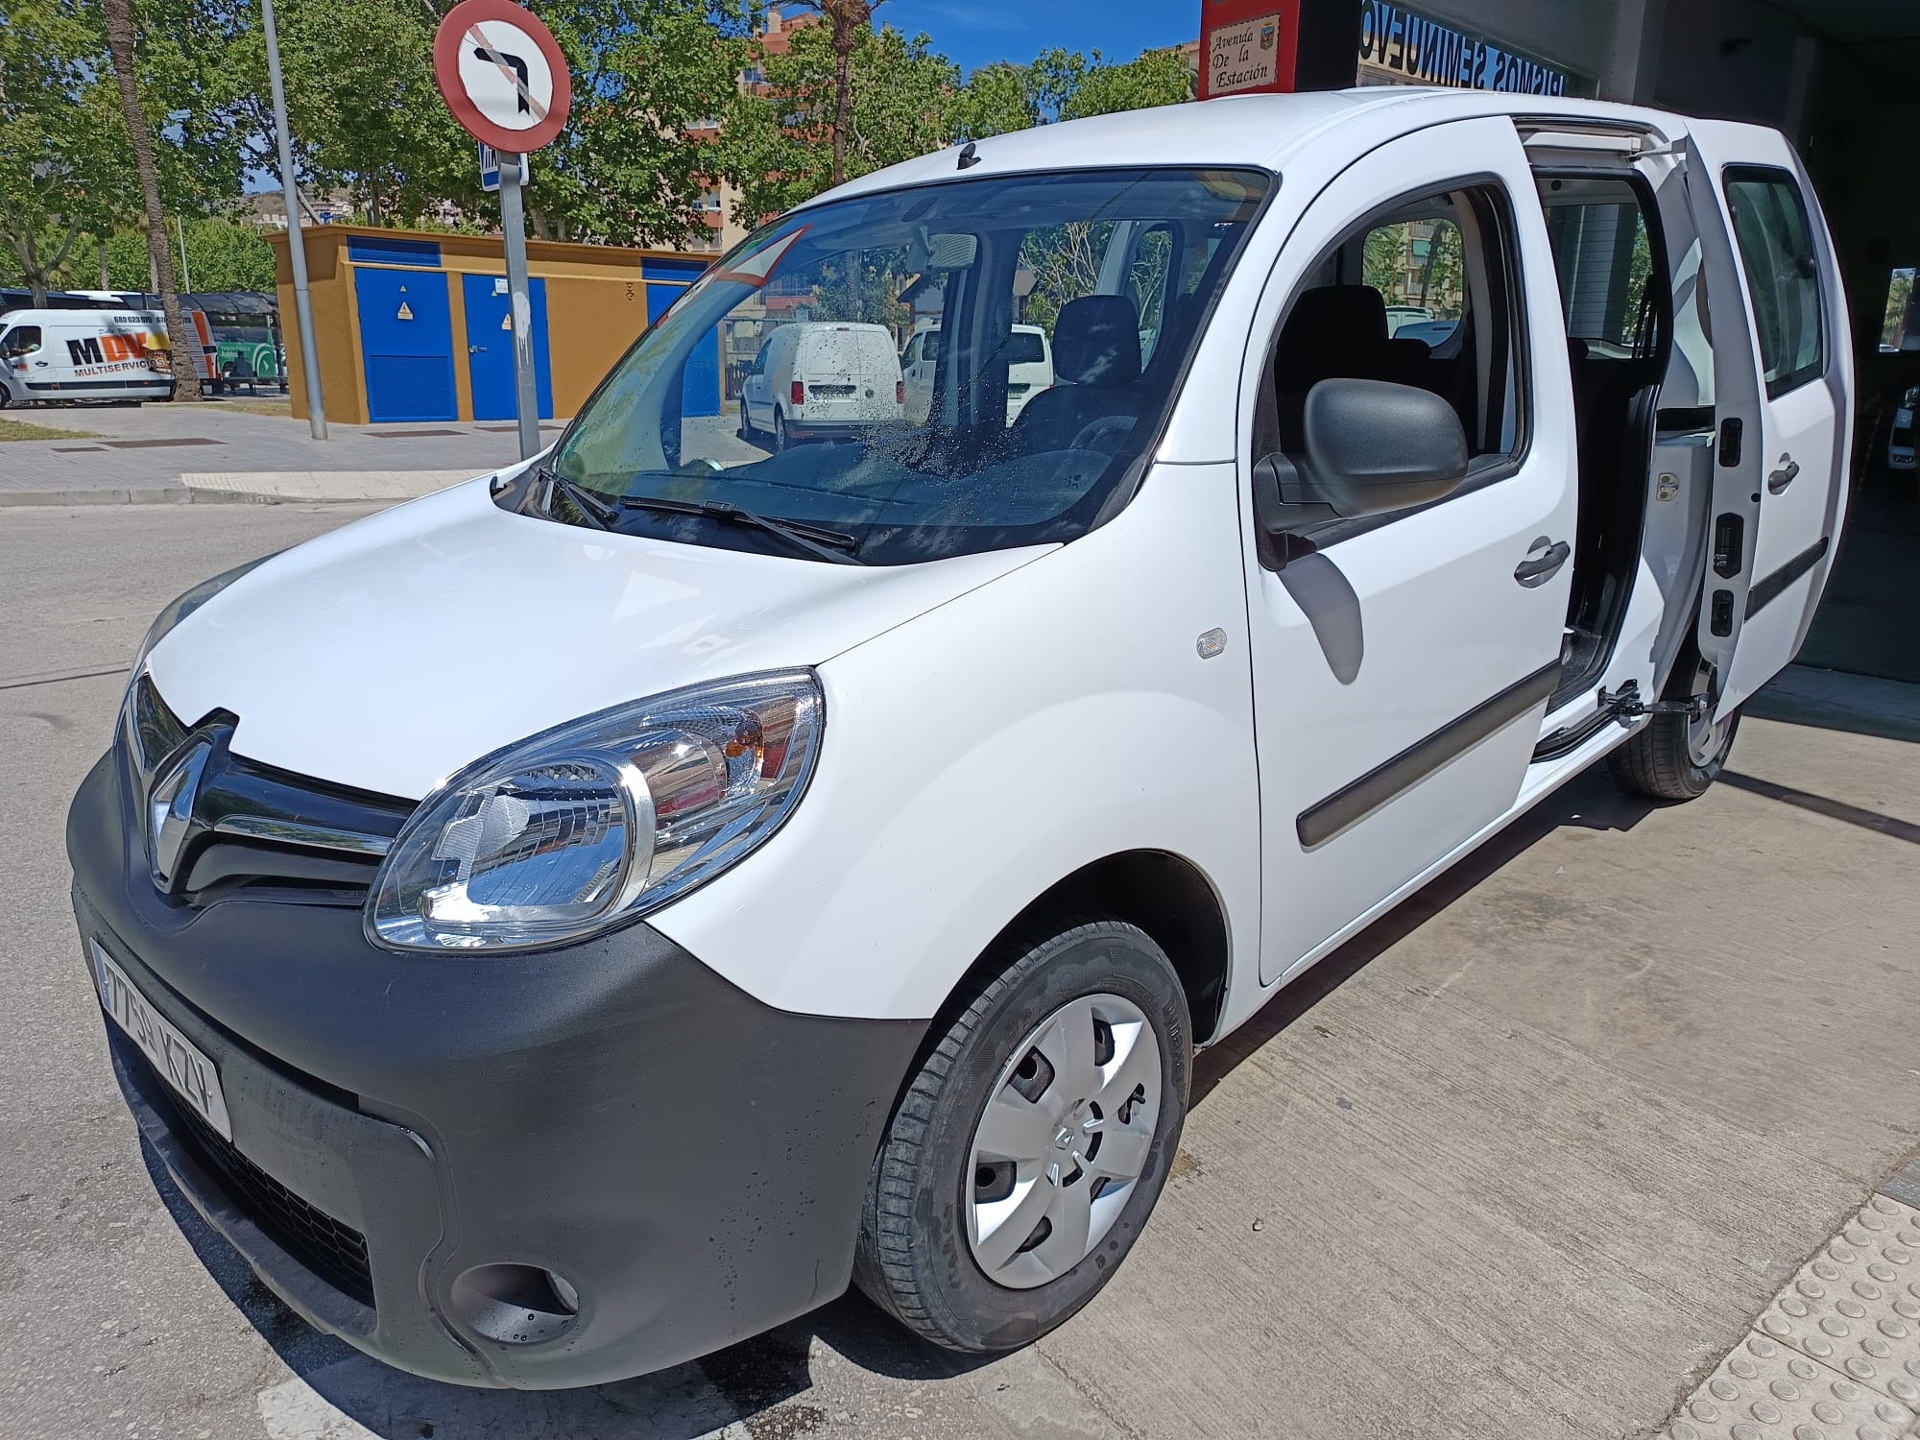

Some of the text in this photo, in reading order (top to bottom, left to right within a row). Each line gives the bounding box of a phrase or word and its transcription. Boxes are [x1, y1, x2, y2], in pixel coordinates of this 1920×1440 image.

[1212, 27, 1253, 52] Avenida
[1212, 44, 1249, 69] De la
[1216, 63, 1268, 88] Estación
[66, 332, 147, 366] MDV
[74, 358, 165, 377] MULTISERVICIOS
